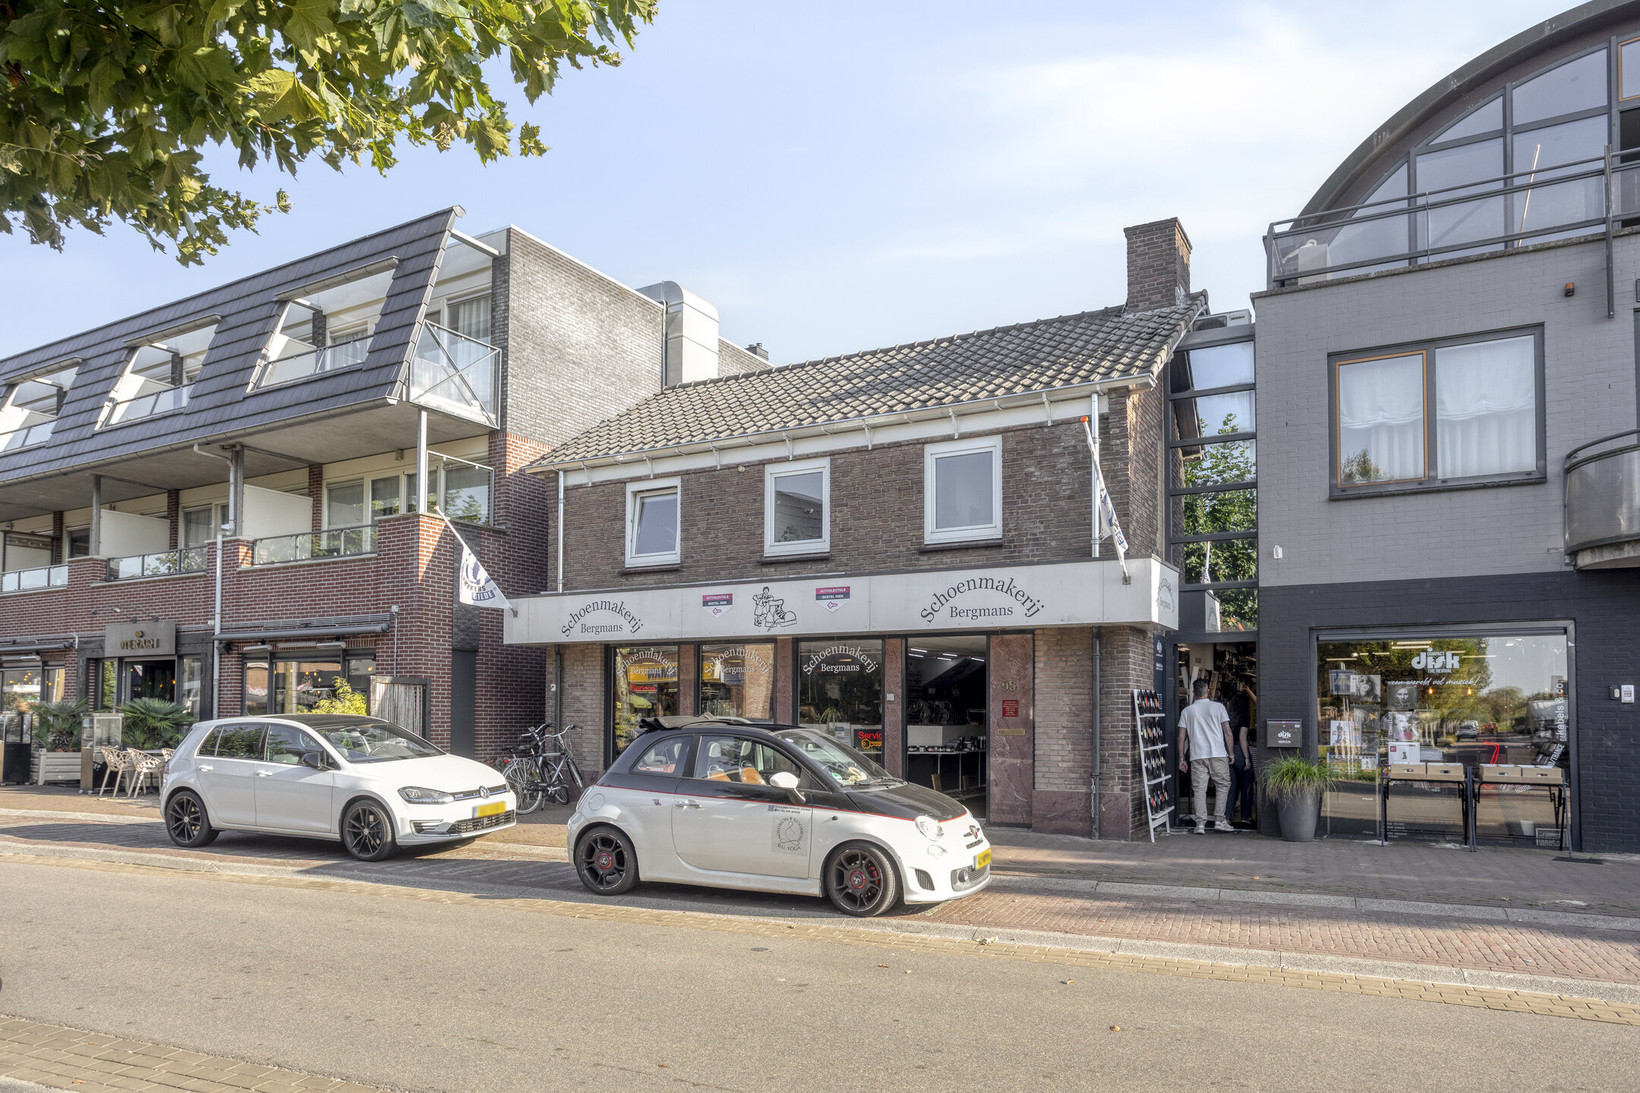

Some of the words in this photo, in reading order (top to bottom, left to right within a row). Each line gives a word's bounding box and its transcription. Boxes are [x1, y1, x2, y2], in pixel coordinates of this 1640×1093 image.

[920, 577, 1045, 623] Schoenmakerij
[561, 600, 644, 637] Schoenmakerij
[949, 606, 1014, 620] Bergmans
[580, 623, 624, 636] Bergmans
[704, 648, 772, 676] Schoenmakerij
[803, 645, 879, 675] Schoenmakerij
[820, 663, 860, 674] Bergmans
[1411, 647, 1460, 669] disk
[630, 666, 663, 676] Bergmans
[1555, 706, 1565, 736] kabels
[858, 731, 882, 739] Servic
